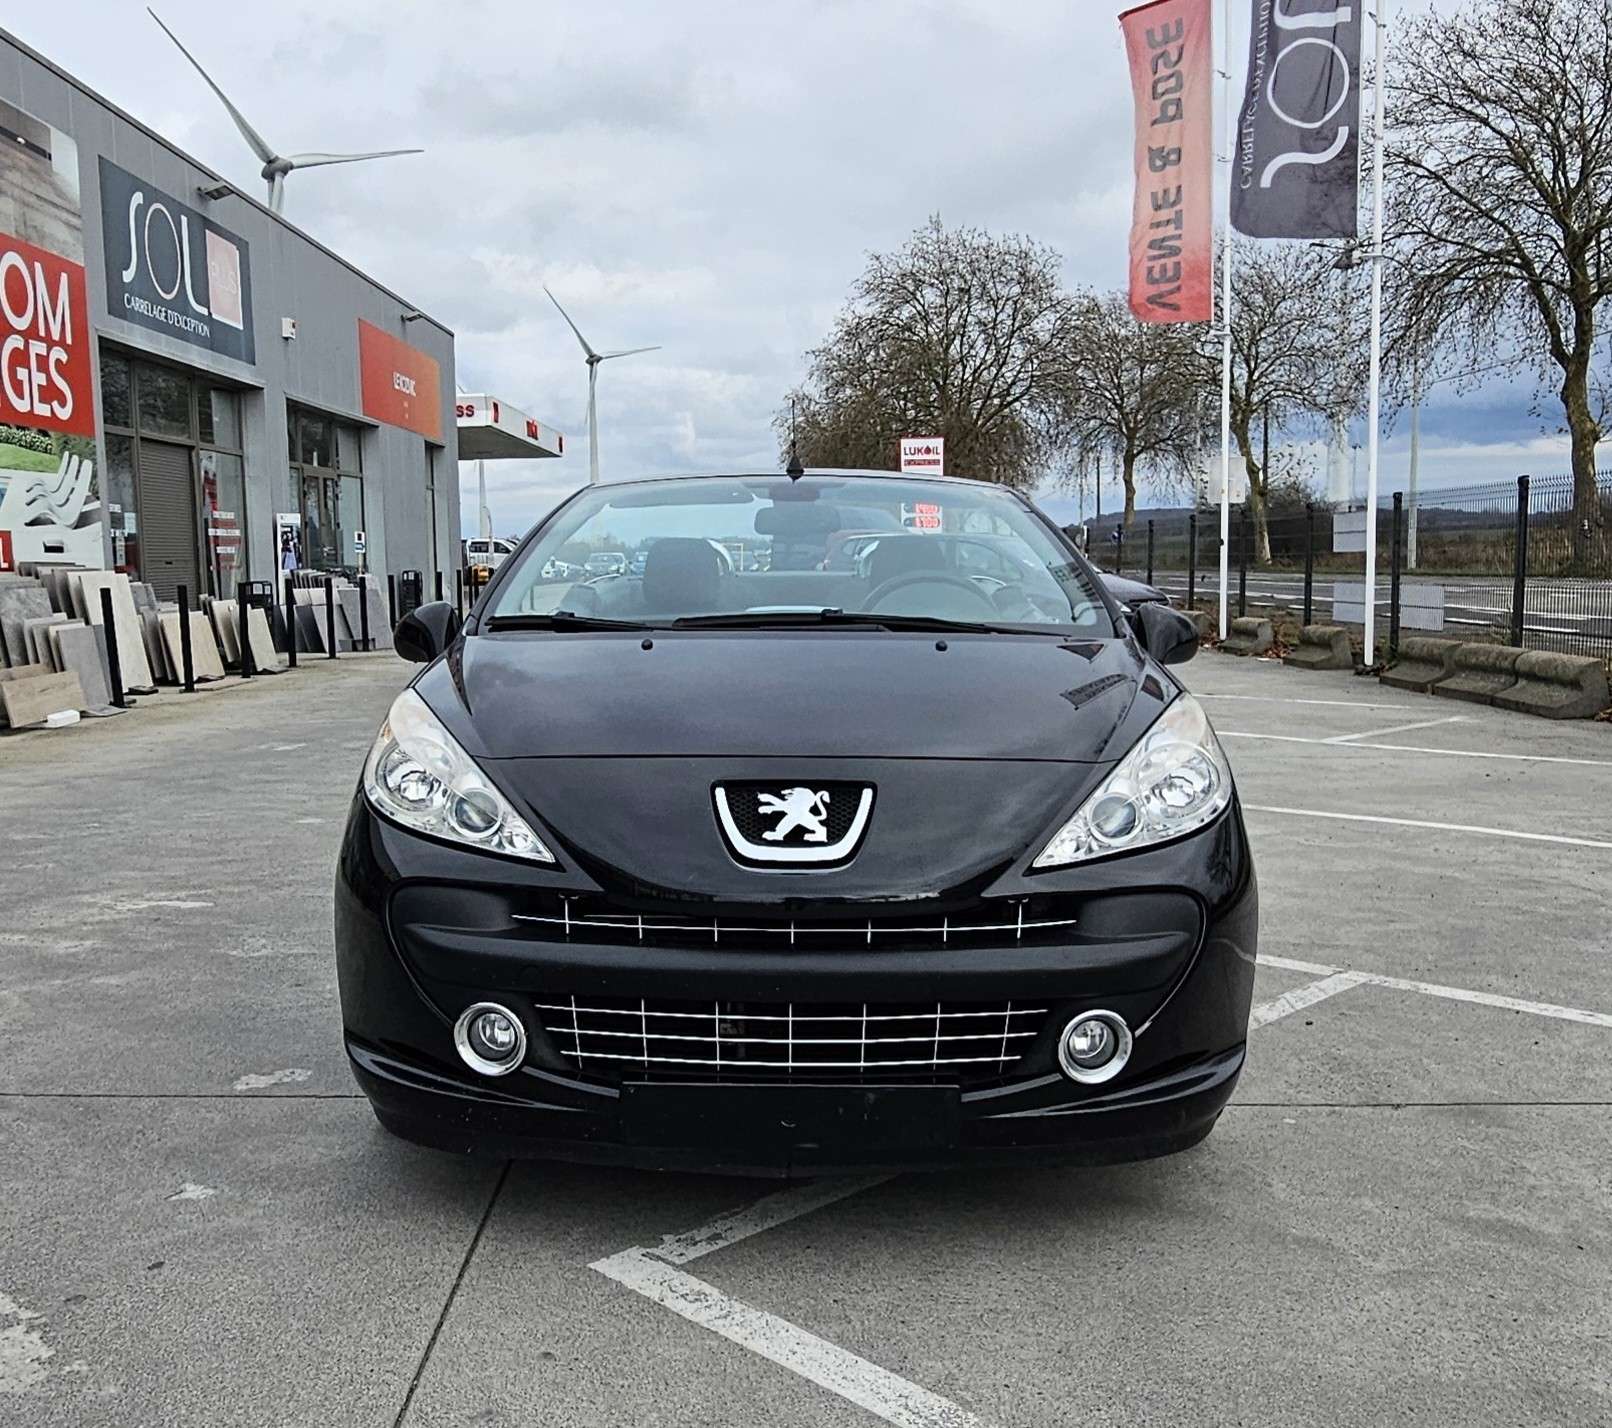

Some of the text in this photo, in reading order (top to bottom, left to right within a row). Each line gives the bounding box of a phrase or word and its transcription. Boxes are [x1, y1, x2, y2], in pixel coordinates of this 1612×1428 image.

[122, 191, 209, 316] SOL
[0, 251, 73, 345] OM
[124, 293, 210, 338] CARRELAGE D'EXCEPTION
[1, 334, 73, 421] GES
[904, 445, 940, 456] LUKOIL
